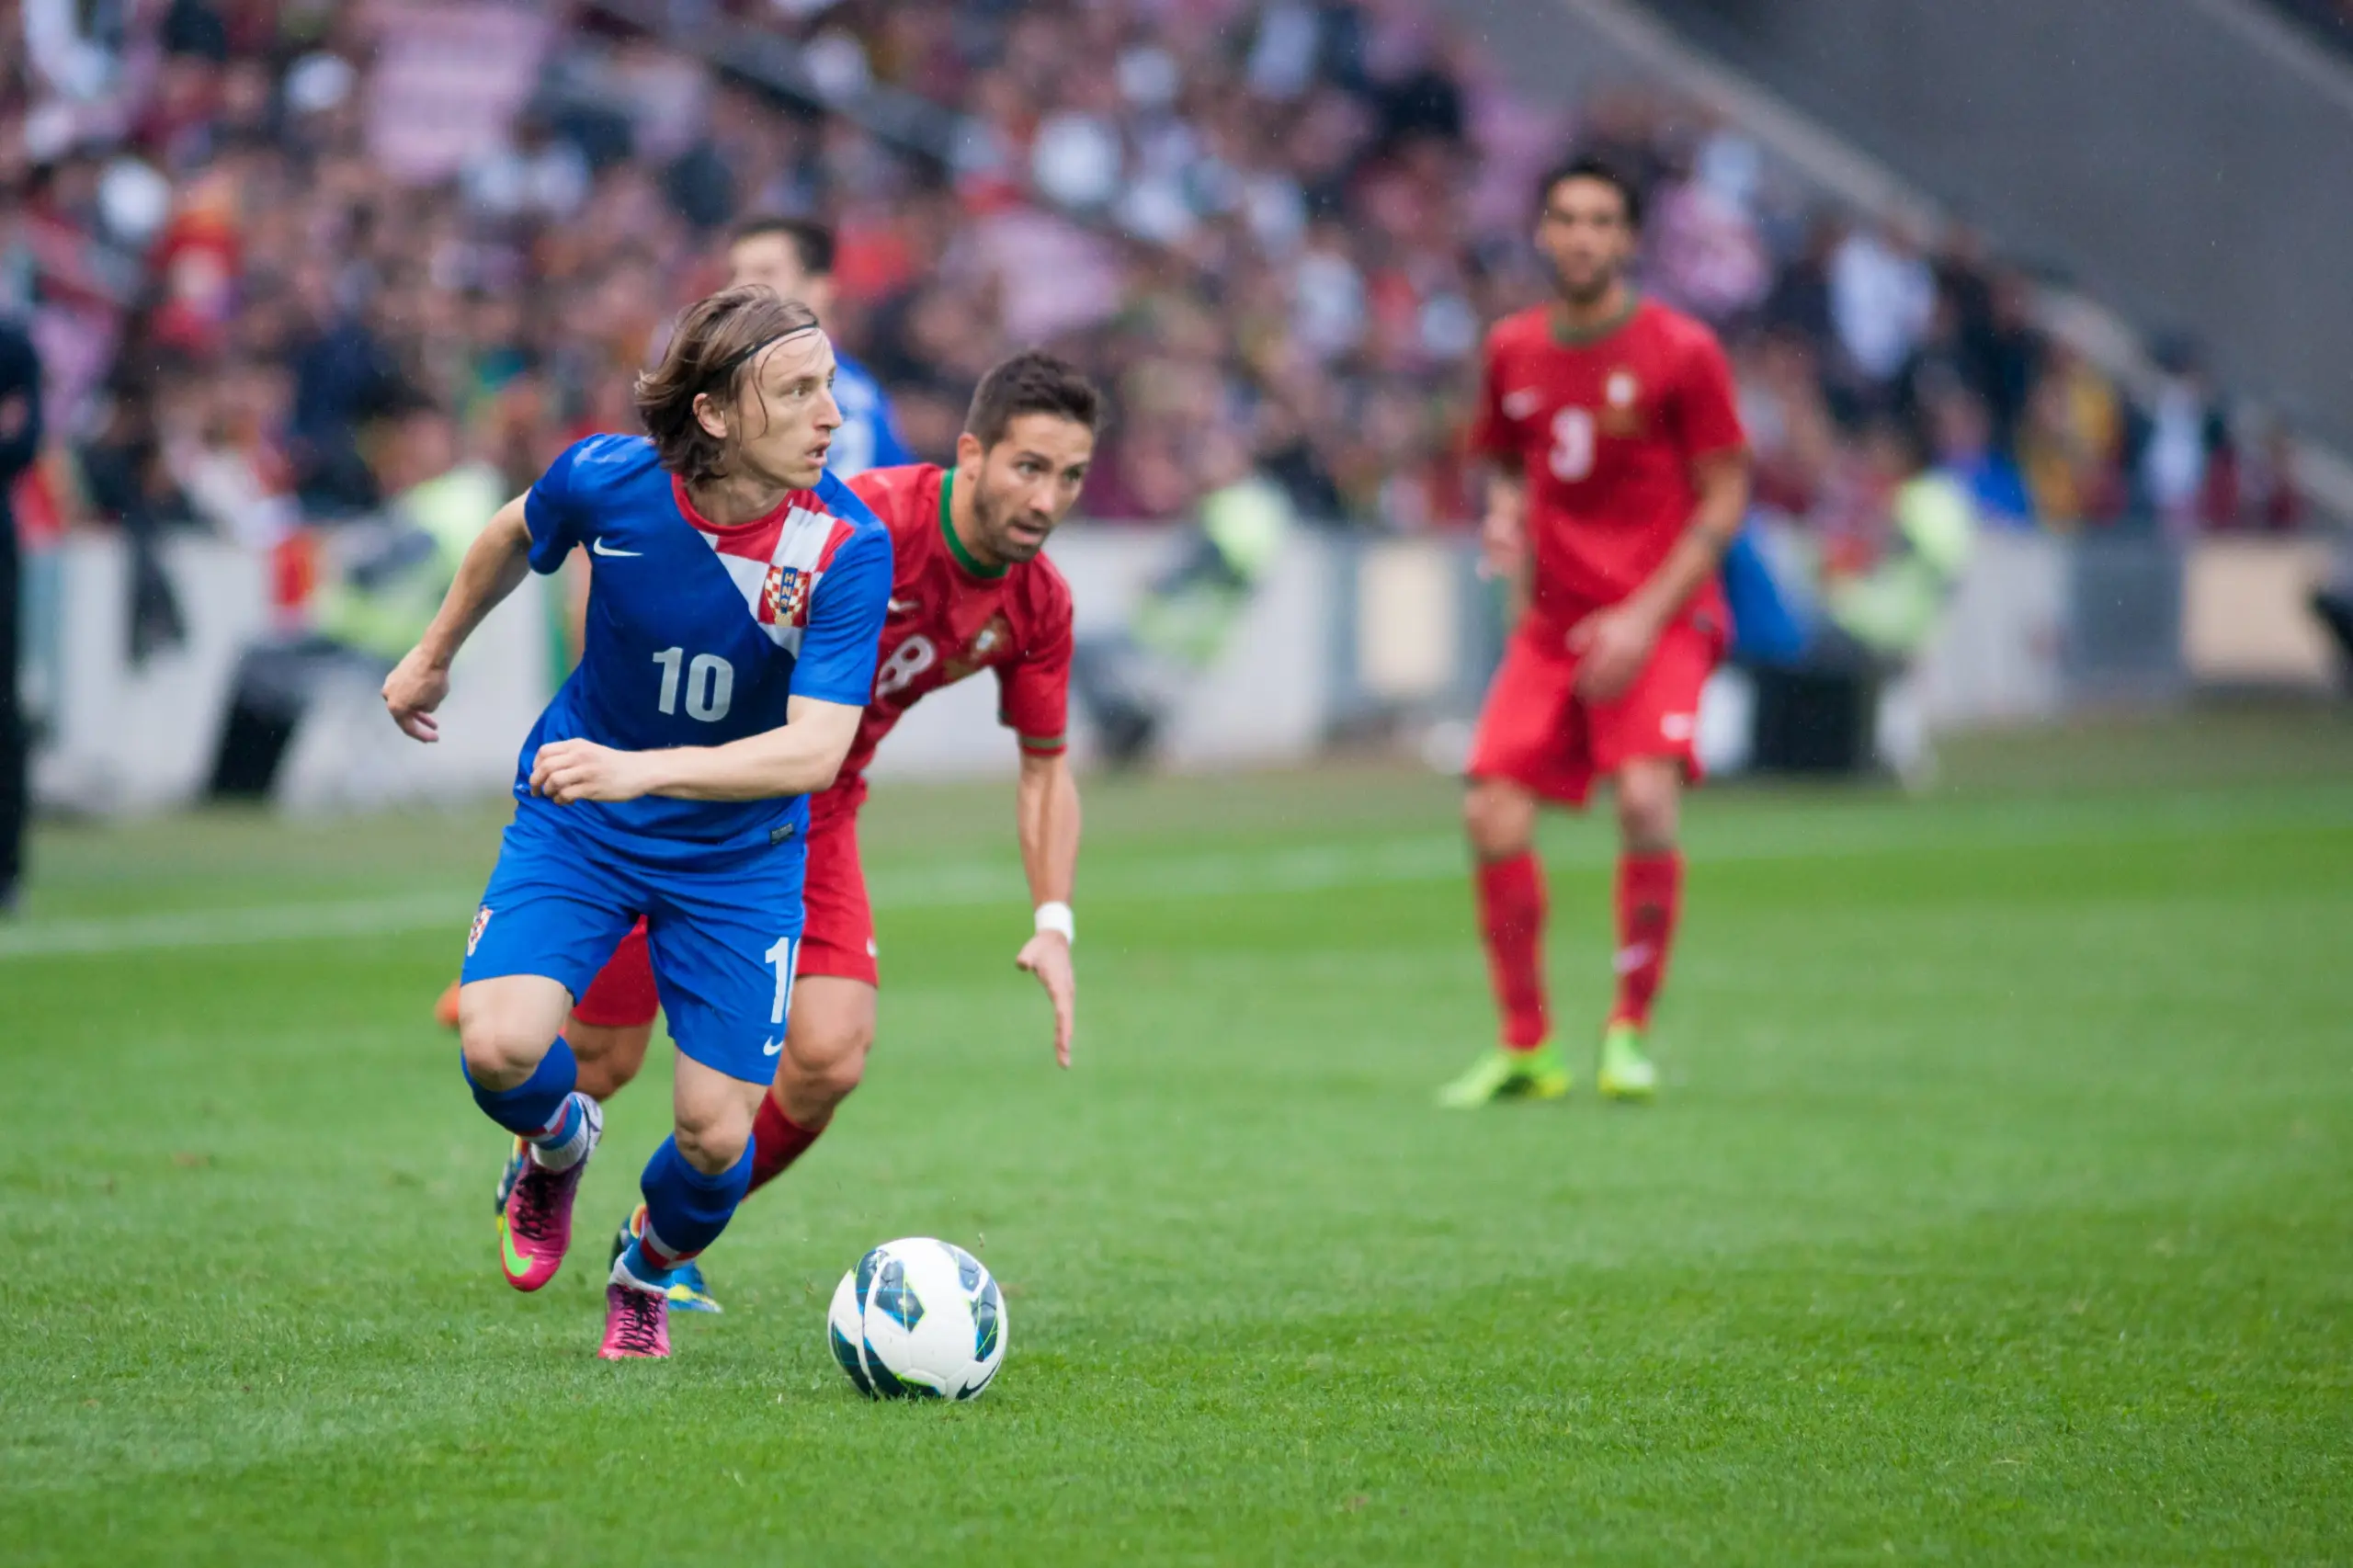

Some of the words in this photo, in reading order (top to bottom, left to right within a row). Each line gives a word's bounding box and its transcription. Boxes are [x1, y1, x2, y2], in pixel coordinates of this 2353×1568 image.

[1549, 406, 1596, 481] 3
[653, 646, 733, 722] 10
[876, 634, 936, 699] 8
